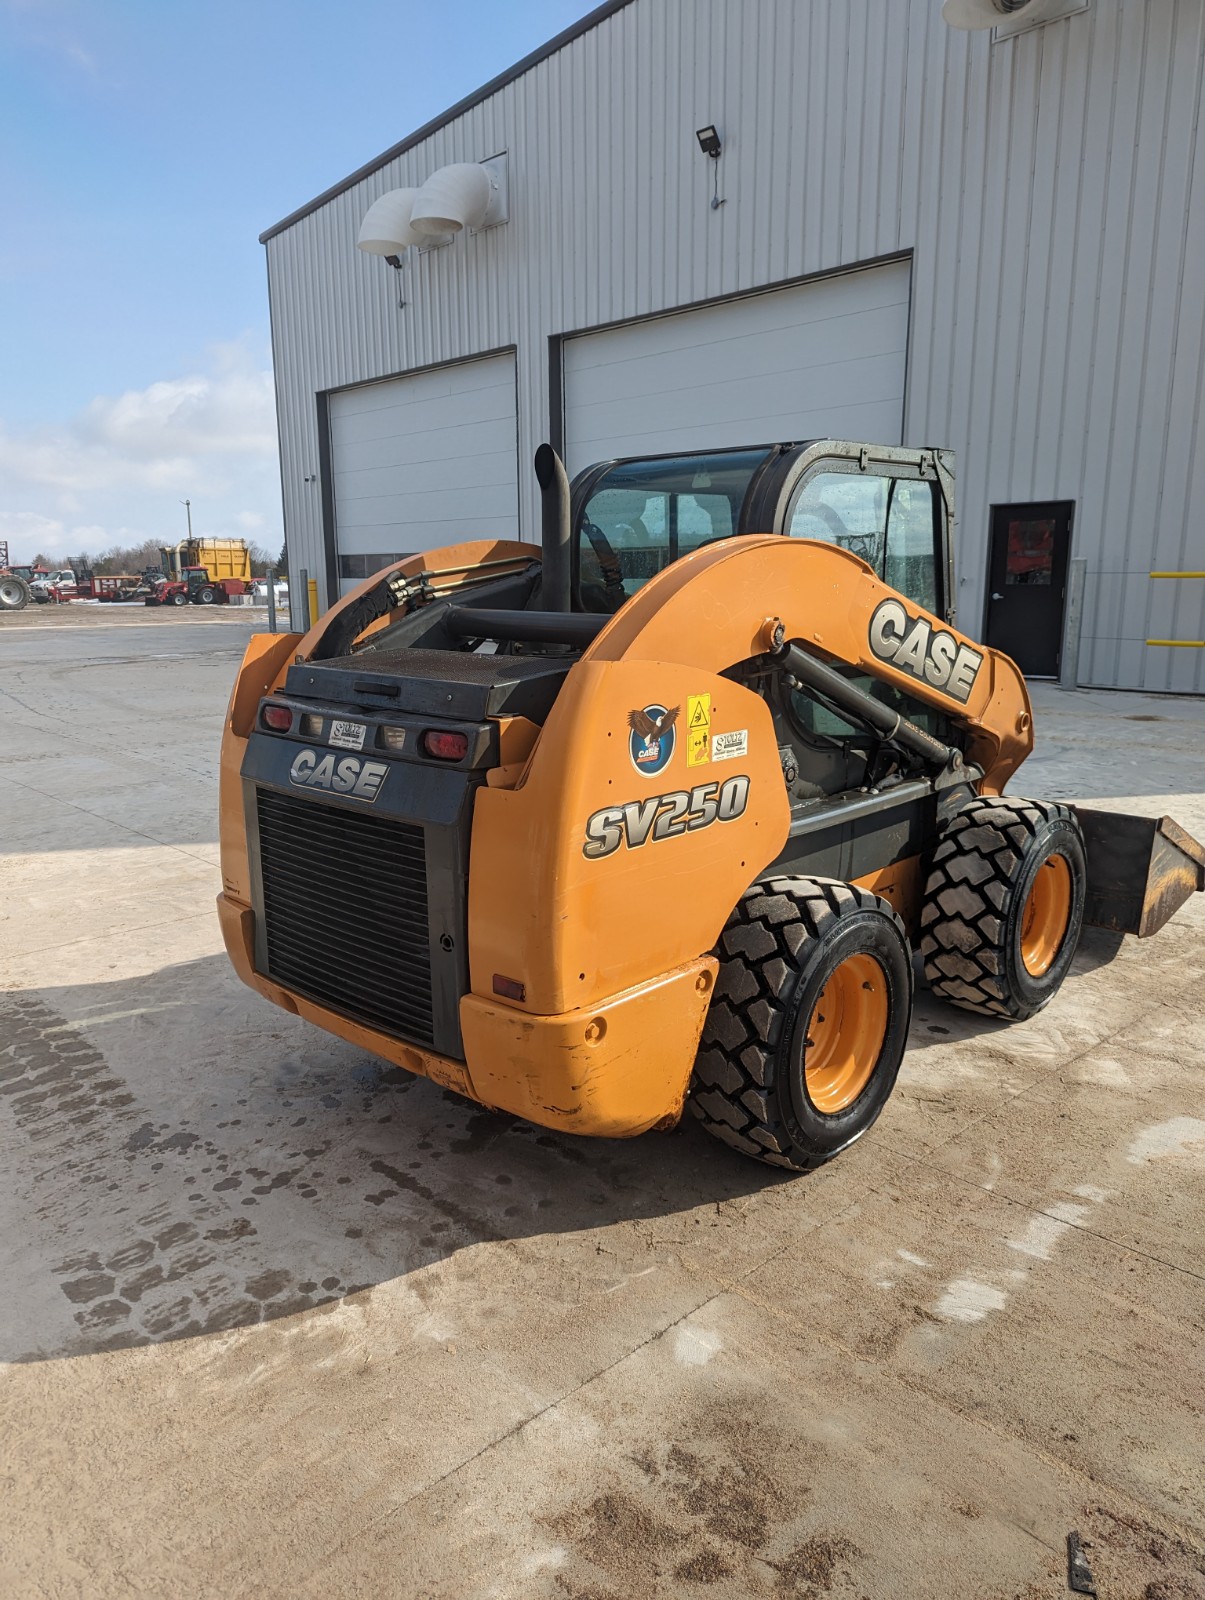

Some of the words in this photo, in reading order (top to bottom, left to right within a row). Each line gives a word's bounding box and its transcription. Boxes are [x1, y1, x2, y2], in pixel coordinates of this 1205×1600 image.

[869, 598, 983, 702] CASE
[290, 749, 389, 799] CASE
[638, 747, 660, 758] CASE
[583, 775, 750, 860] SV250
